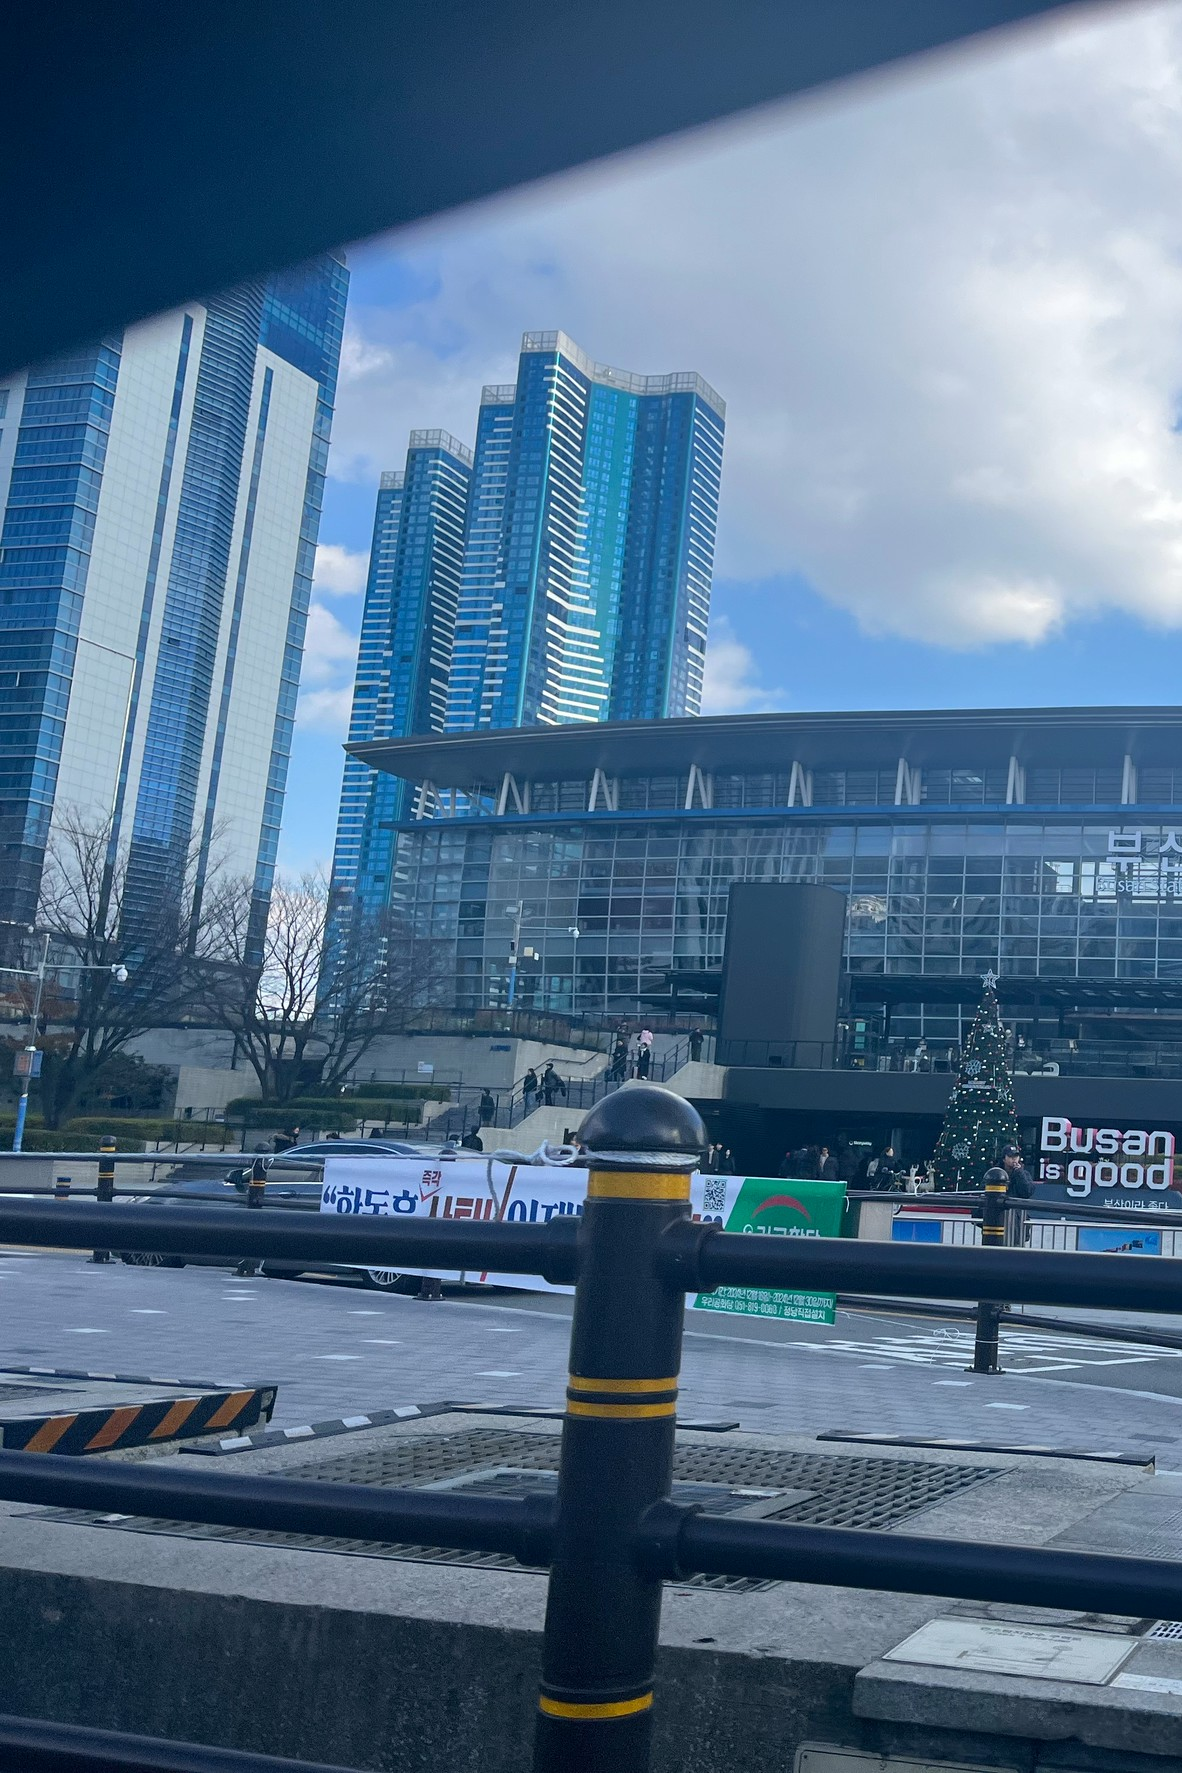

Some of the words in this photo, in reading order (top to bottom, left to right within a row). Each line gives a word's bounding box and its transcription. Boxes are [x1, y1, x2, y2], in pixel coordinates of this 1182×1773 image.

[1040, 1116, 1175, 1157] Busan
[421, 1170, 442, 1187] 즉각
[1039, 1157, 1062, 1180] is
[1066, 1157, 1173, 1198] good
[701, 1296, 734, 1311] 우리공화당
[783, 1305, 826, 1321] 정당직접설치
